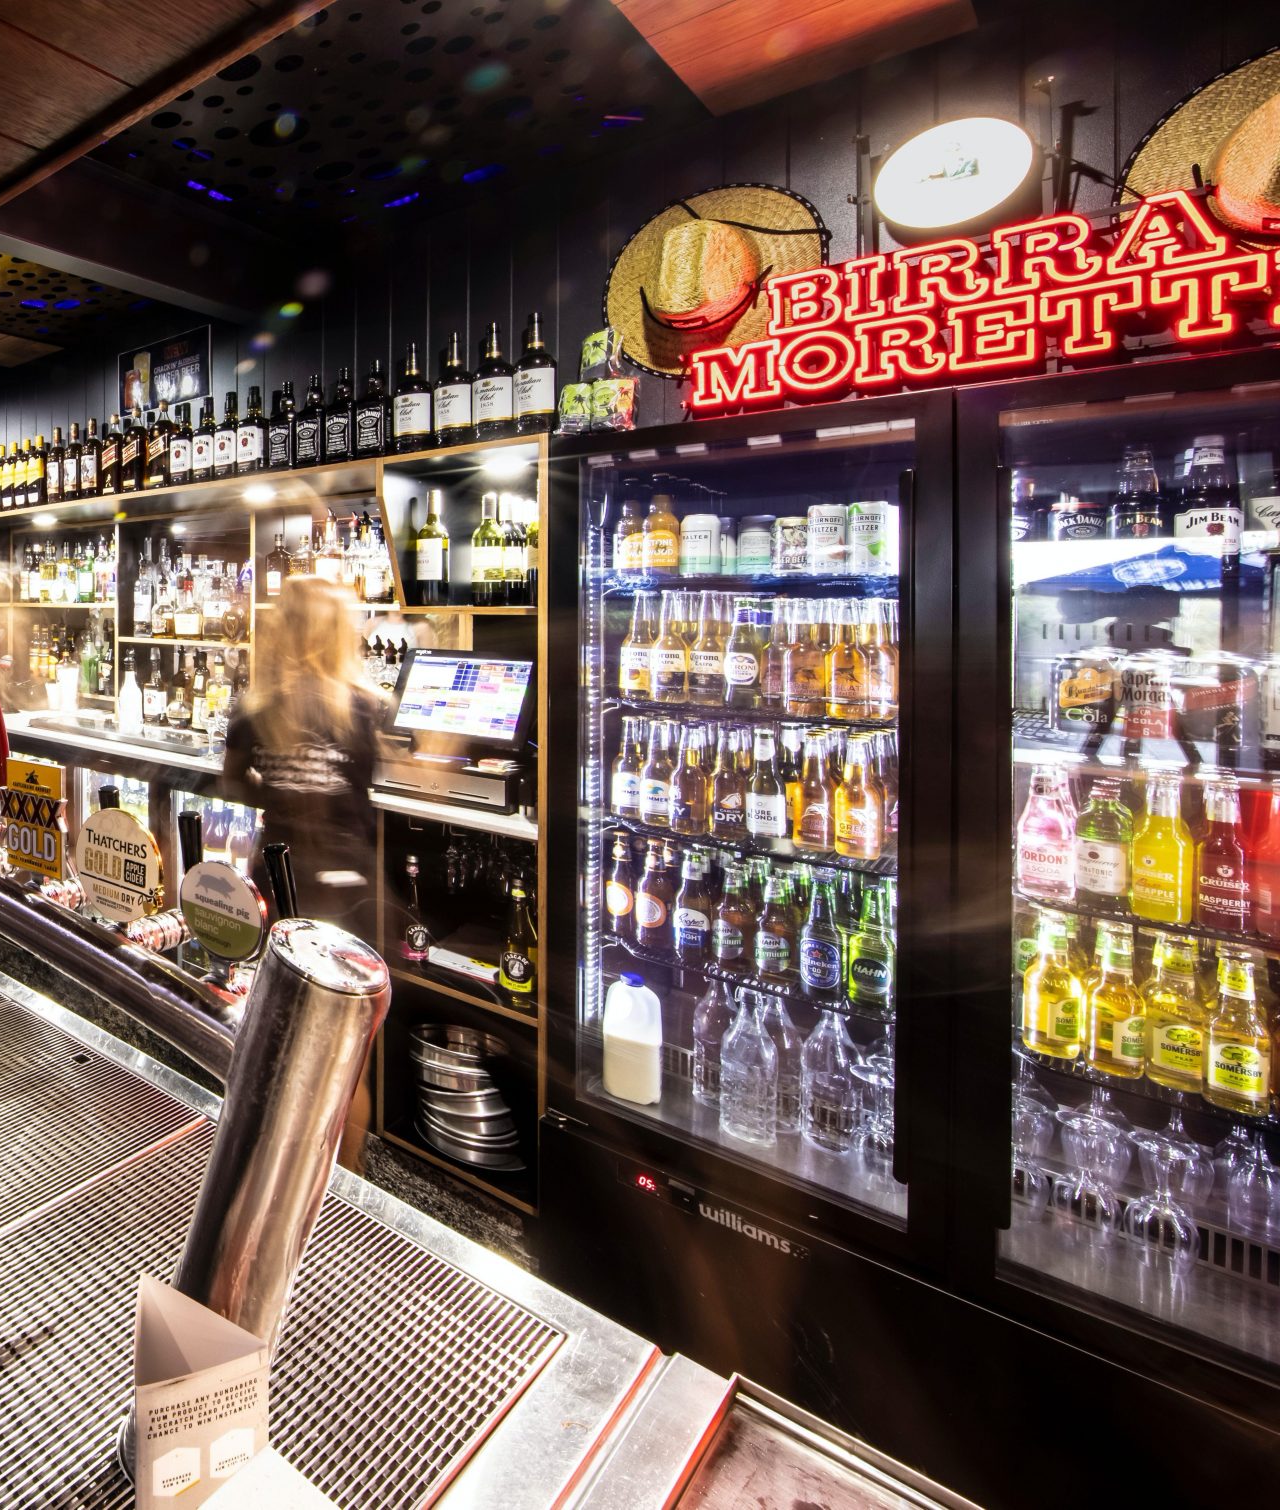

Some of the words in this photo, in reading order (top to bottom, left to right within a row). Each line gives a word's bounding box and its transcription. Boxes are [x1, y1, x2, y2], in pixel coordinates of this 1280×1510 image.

[766, 189, 1227, 338] BIRRA
[691, 249, 1280, 408] MORETT
[1136, 513, 1163, 528] BEAM
[1186, 515, 1208, 528] JIM
[1211, 512, 1240, 527] BEAM
[1065, 707, 1108, 723] Cola
[1132, 717, 1163, 726] COLA
[0, 787, 63, 831] XXXX
[714, 812, 744, 822] DRY
[8, 823, 56, 862] GOLD
[86, 828, 147, 859] THATCHERS
[84, 847, 122, 880] GOLD
[126, 861, 144, 876] APPLE
[1032, 864, 1060, 874] SODA
[126, 872, 144, 886] CIDER
[1200, 876, 1250, 890] CRUISER
[92, 883, 120, 900] MEDIUM
[121, 892, 136, 906] DRY
[1198, 894, 1250, 908] RASPBERRY
[195, 893, 234, 914] squealing
[236, 908, 250, 920] pig
[194, 907, 241, 932] sauvignon
[194, 918, 219, 934] blanc
[504, 954, 529, 966] CASCADE
[854, 964, 887, 979] HAHN
[1214, 1060, 1262, 1078] SOMERSBY
[698, 1203, 791, 1254] williams
[148, 1400, 190, 1416] PURCHASE
[196, 1395, 210, 1404] ANY
[214, 1378, 258, 1398] BUNDABERG
[151, 1414, 168, 1423] RUM
[173, 1403, 208, 1418] PRODUCT
[212, 1398, 221, 1406] TO
[226, 1386, 256, 1402] RECEIVE
[148, 1427, 179, 1440] CHANCE
[197, 1417, 211, 1426] WIN
[216, 1401, 255, 1420] INSTANTLY
[158, 1415, 194, 1430] SCRATCH
[198, 1407, 218, 1418] CARD
[222, 1402, 235, 1410] FOR
[240, 1392, 258, 1404] YOUR
